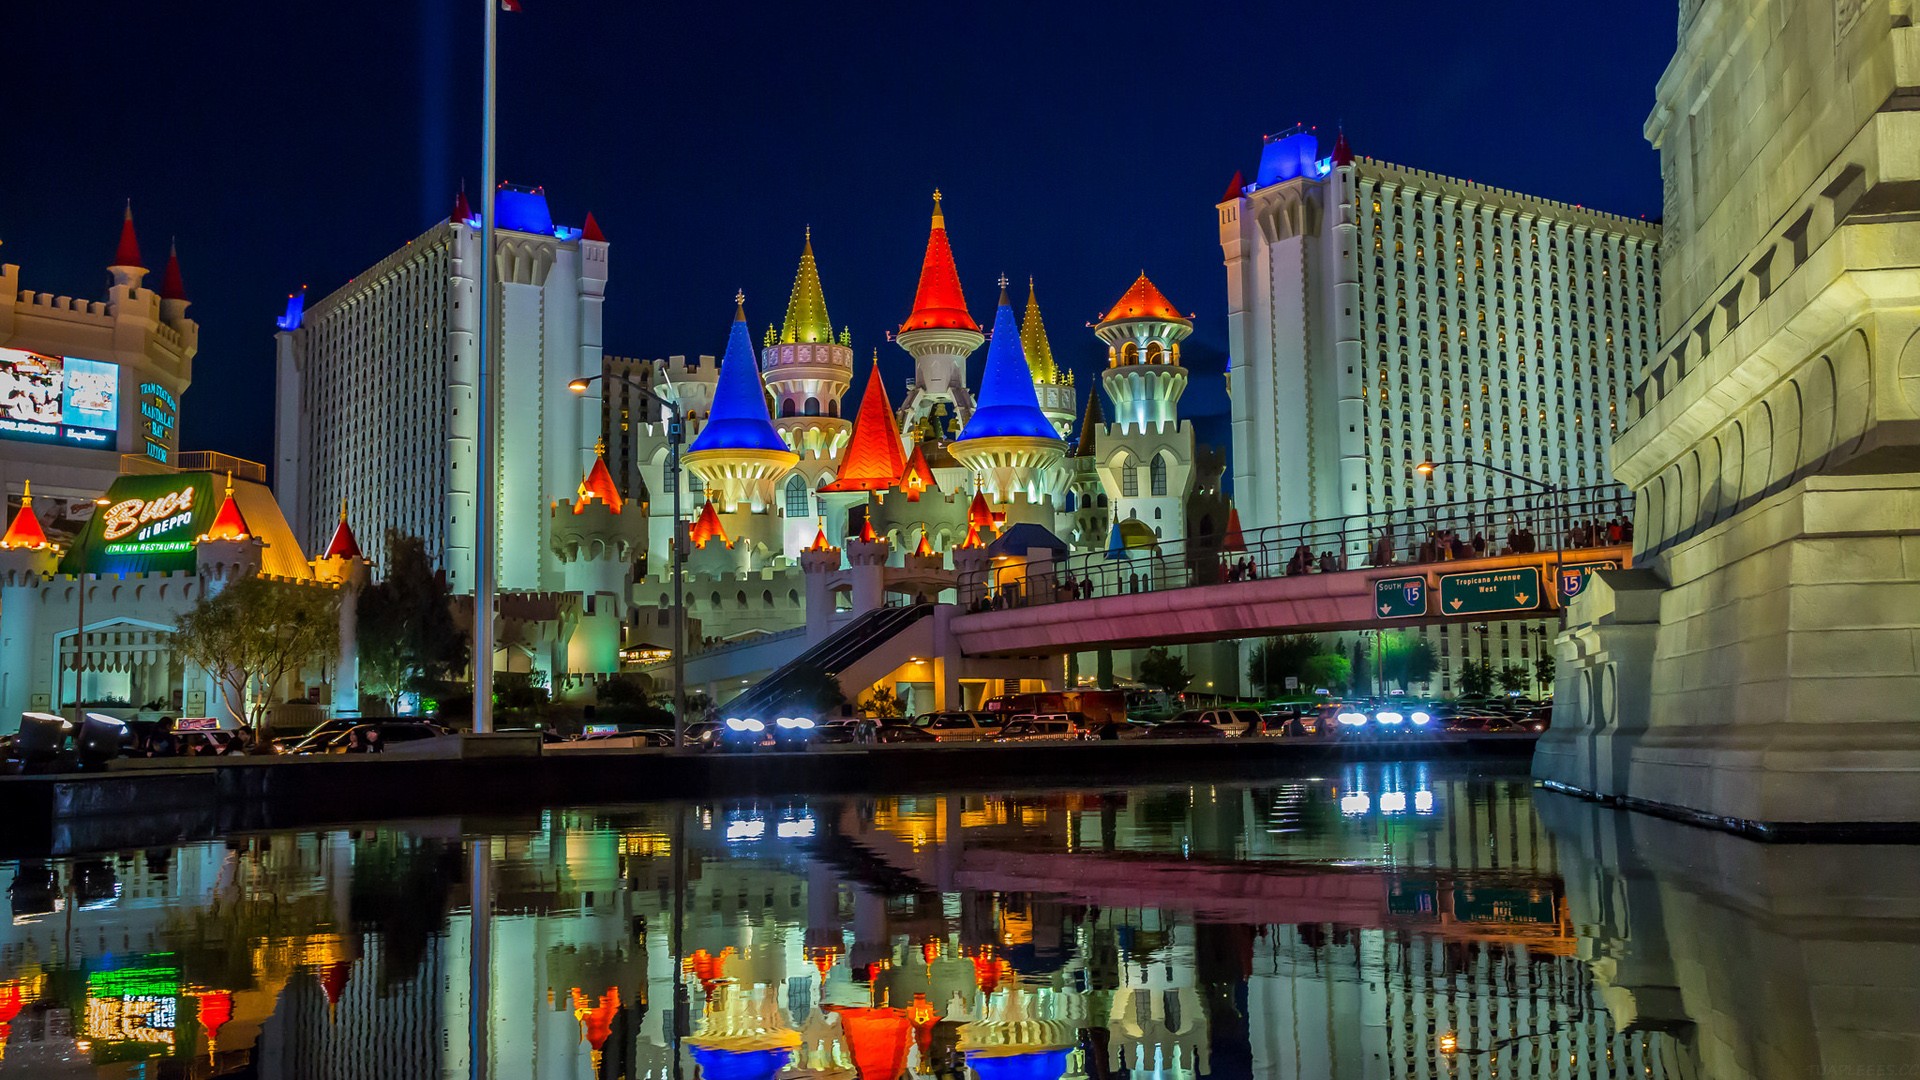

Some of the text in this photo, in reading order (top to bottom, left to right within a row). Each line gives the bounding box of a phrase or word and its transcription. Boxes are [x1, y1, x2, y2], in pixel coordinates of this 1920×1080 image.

[141, 401, 175, 429] MANDALAY
[152, 421, 164, 439] BAY
[146, 441, 167, 464] LUXOR
[138, 511, 192, 541] di BEPPO
[107, 542, 190, 553] ITALIAN RESTAURANT
[1456, 574, 1521, 586] Tropicana Avenue
[1563, 576, 1579, 592] 15
[1407, 587, 1420, 601] 15
[1479, 585, 1497, 593] West
